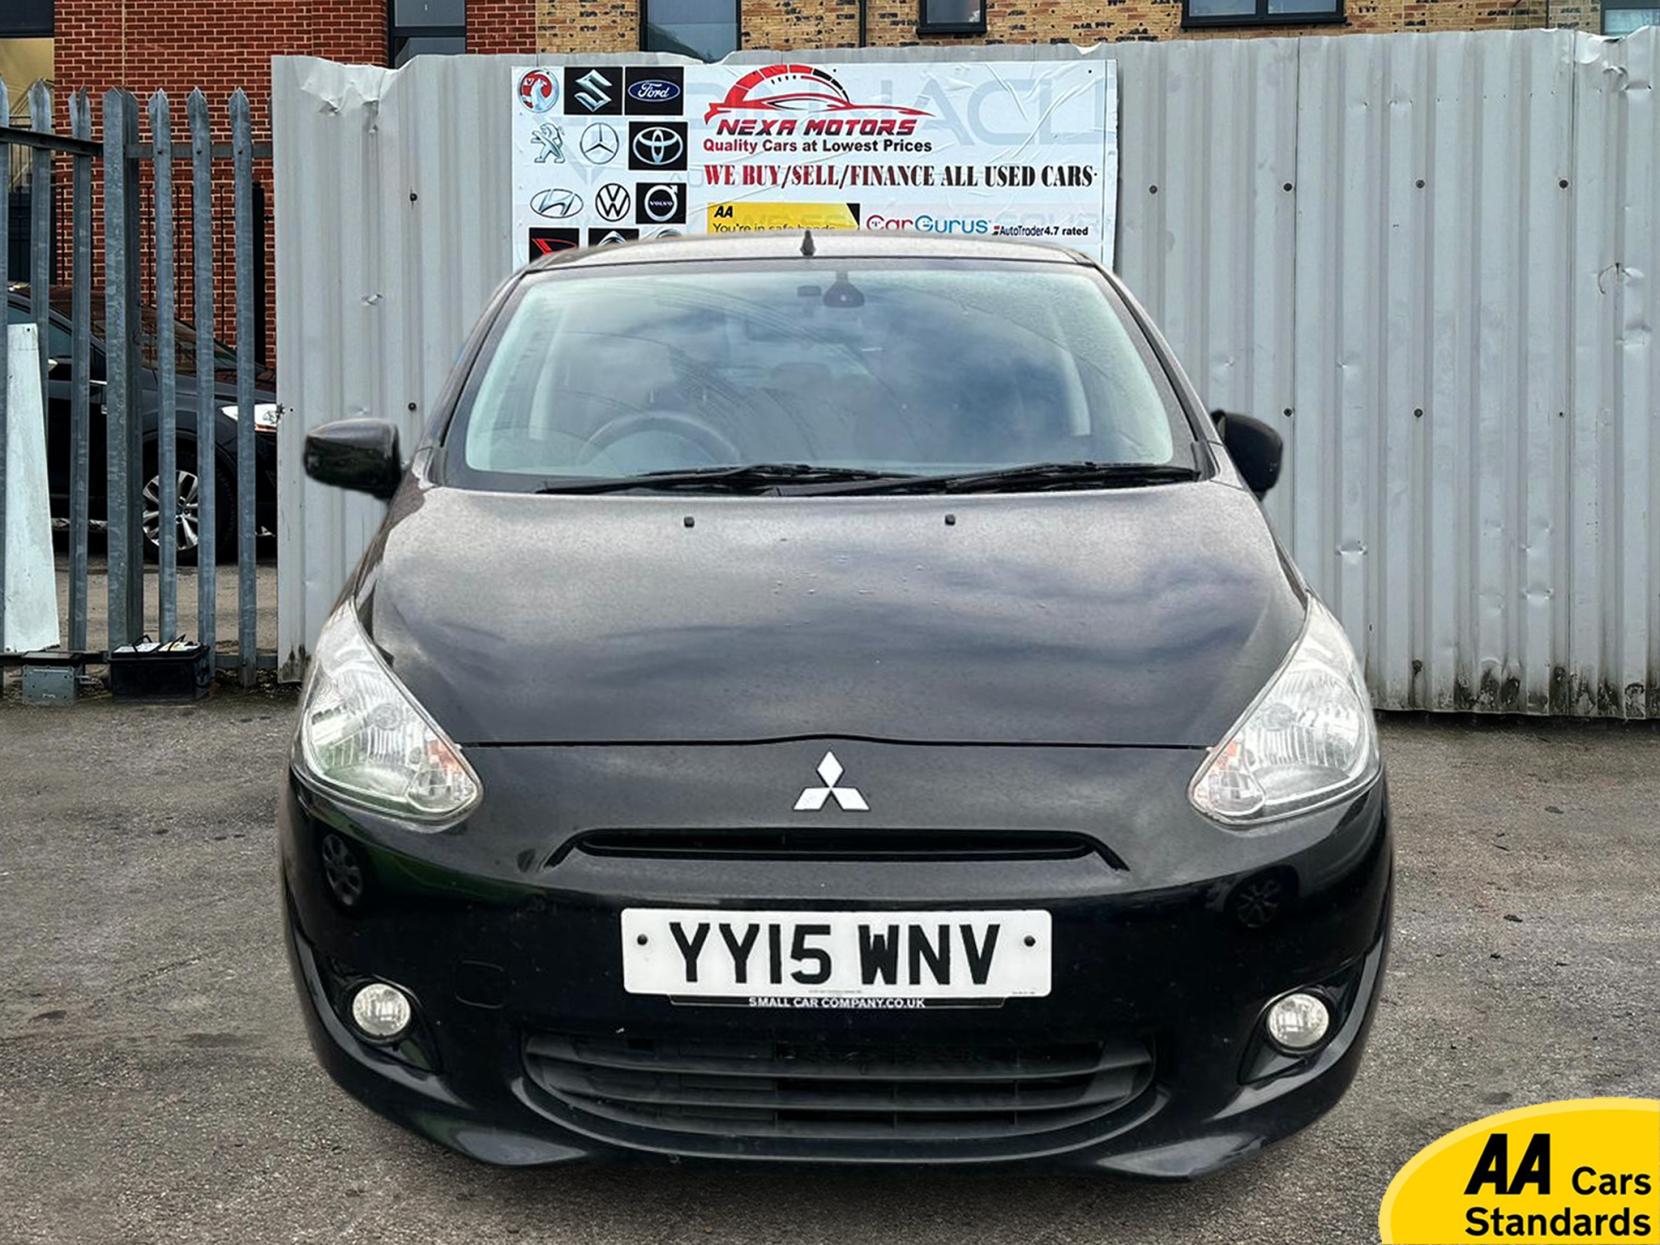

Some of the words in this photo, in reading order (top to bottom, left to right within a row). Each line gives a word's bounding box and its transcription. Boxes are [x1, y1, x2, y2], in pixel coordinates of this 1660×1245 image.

[638, 82, 670, 98] Ford
[716, 119, 798, 136] NEXA
[803, 118, 918, 136] MOTORS
[703, 138, 758, 154] Quality
[762, 139, 797, 152] Cars
[802, 139, 818, 152] at
[822, 139, 878, 152] Lowest
[883, 139, 933, 152] Prices
[704, 164, 736, 186] WE
[742, 164, 935, 190] BUY/SELL/FINANCE
[941, 165, 978, 187] ALL
[984, 165, 1036, 187] USED
[714, 205, 733, 218] AA
[866, 214, 989, 235] CarGurus
[1062, 226, 1089, 236] rated
[669, 922, 832, 985] YY15
[857, 923, 1001, 986] WNV
[749, 997, 791, 1008] SMALL
[793, 997, 819, 1008] CAR
[821, 997, 926, 1009] COMPANY.CO.UK
